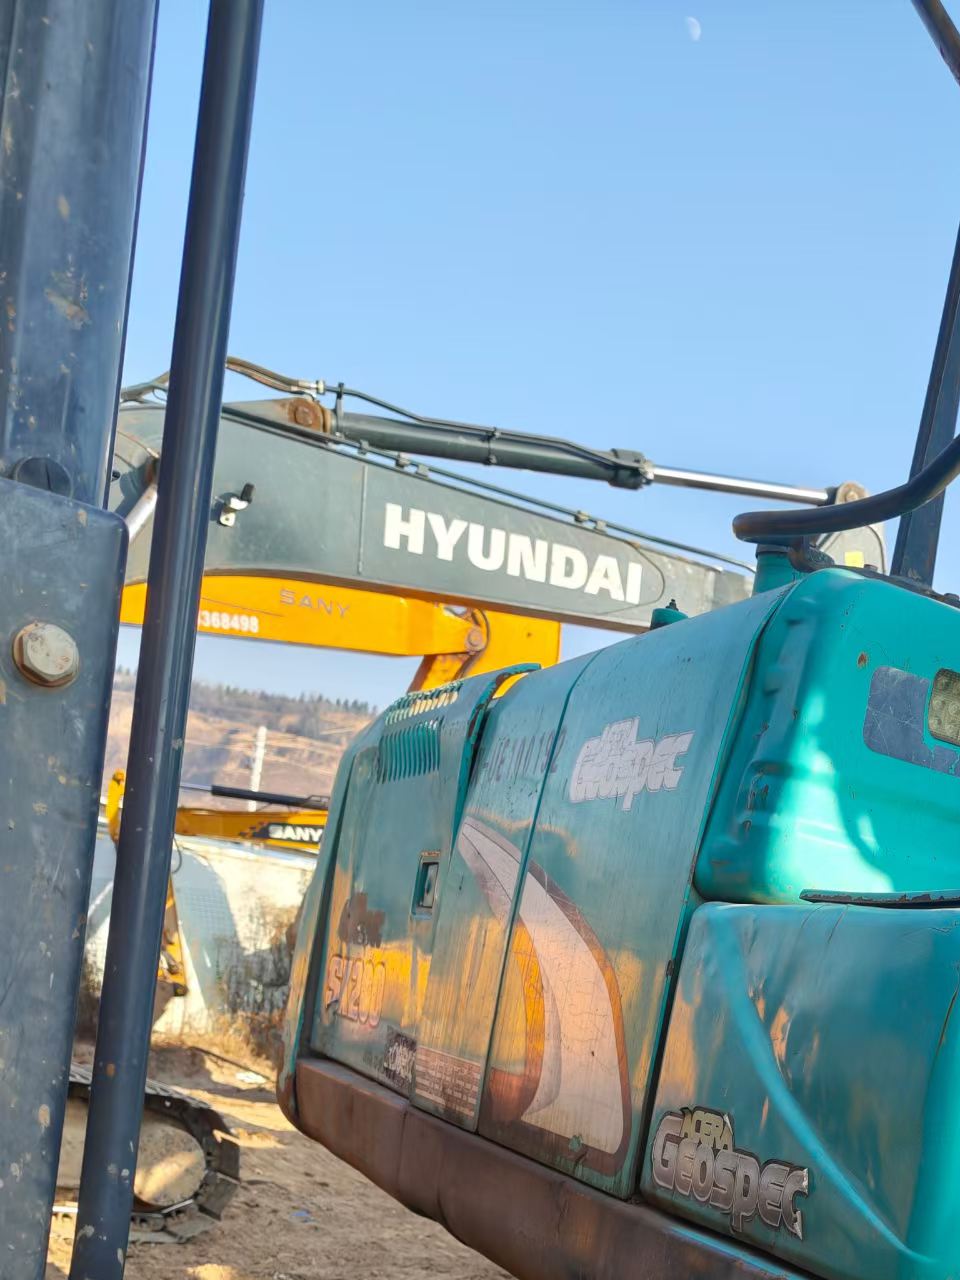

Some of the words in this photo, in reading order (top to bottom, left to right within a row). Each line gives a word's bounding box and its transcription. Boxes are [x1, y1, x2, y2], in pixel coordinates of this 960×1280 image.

[384, 503, 643, 605] HYUNDAI
[280, 588, 351, 618] SANY
[198, 610, 260, 633] 368498
[268, 824, 324, 842] SANY
